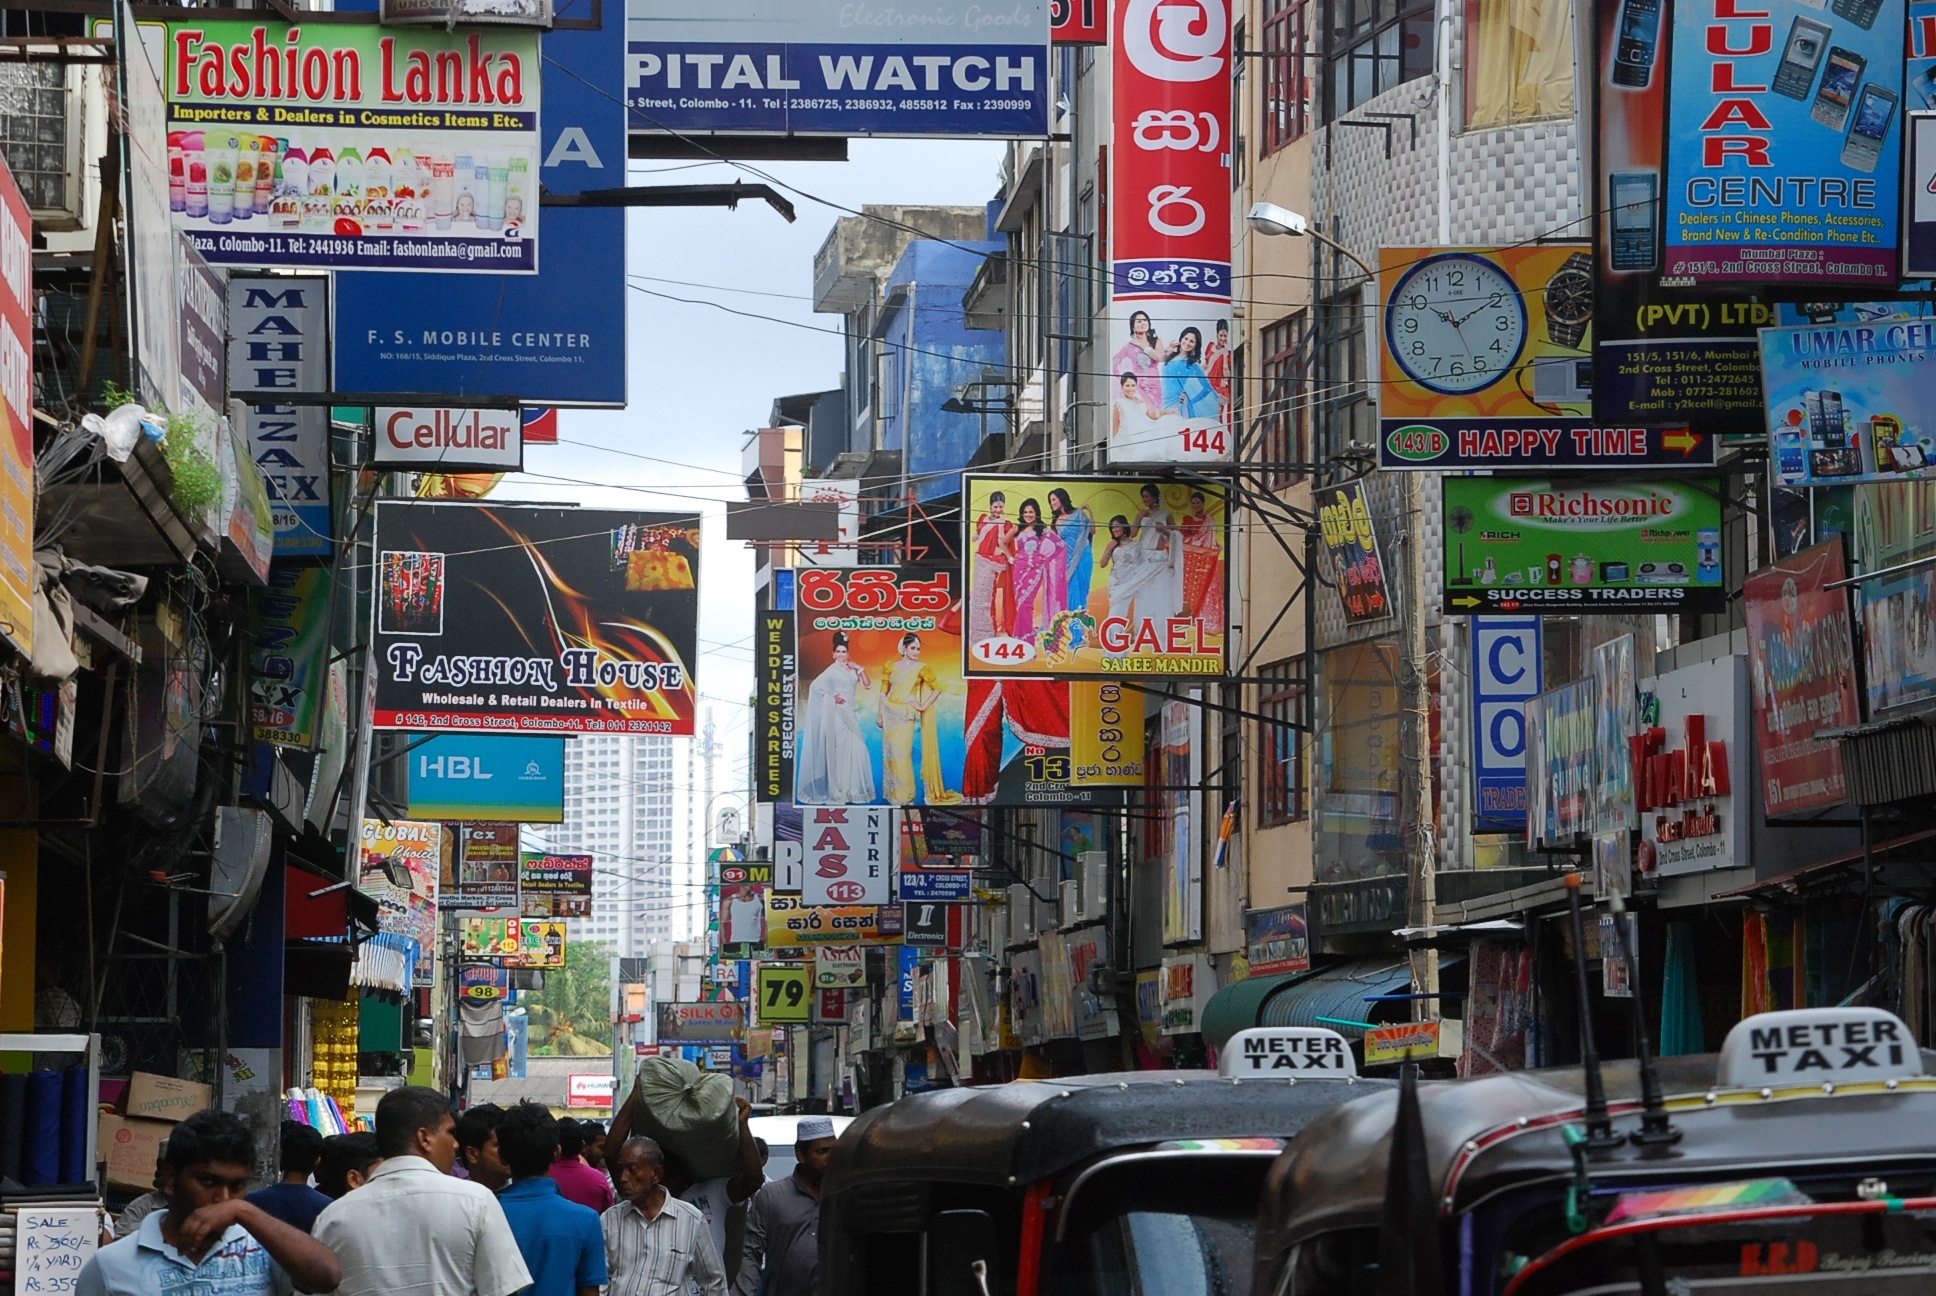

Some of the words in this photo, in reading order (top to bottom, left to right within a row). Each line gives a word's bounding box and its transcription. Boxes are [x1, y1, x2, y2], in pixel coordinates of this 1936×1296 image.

[840, 3, 956, 29] Electronic
[964, 3, 1033, 29] Goods
[172, 26, 364, 104] Fashion
[378, 33, 525, 106] Lanka
[818, 55, 1035, 92] WATCH
[638, 98, 677, 110] Street,
[679, 98, 730, 110] Colombo
[763, 99, 781, 110] Tel
[790, 99, 843, 112] 2386725,
[845, 99, 898, 112] 2386932,
[899, 99, 948, 111] 4855812
[953, 100, 974, 111] Fax
[984, 99, 1032, 112] 2390999
[173, 104, 252, 122] Importers
[256, 109, 270, 122] &
[275, 108, 335, 125] Dealers
[340, 111, 356, 125] in
[360, 110, 441, 127] Cosmetics
[445, 113, 489, 128] Items
[493, 114, 524, 129] Etc.
[543, 126, 605, 169] A
[1686, 177, 1876, 209] CENTRE
[1679, 212, 1718, 225] Dealers
[1721, 212, 1732, 224] in
[1735, 212, 1778, 225] Chinese
[1781, 212, 1822, 227] Phones,
[1825, 213, 1885, 228] Accessories,
[1681, 229, 1712, 242] Brand
[1715, 229, 1741, 242] New
[1743, 229, 1751, 241] &
[1753, 229, 1824, 242] Re-Condition
[1827, 229, 1858, 242] Phone
[219, 236, 286, 254] Colombo-11.
[288, 237, 307, 253] Tel:
[309, 239, 355, 255] 2441936
[357, 240, 391, 256] Email:
[393, 240, 522, 260] fashonlanka@gmail.com
[1788, 249, 1816, 261] Plaza
[1722, 262, 1743, 274] 2nd
[1746, 263, 1780, 274] Cross
[1783, 263, 1823, 276] Street,
[1827, 263, 1872, 276] Colombo
[1636, 303, 1710, 332] (PVT)
[1720, 303, 1774, 326] LTD.
[368, 330, 385, 345] F.
[394, 331, 413, 345] S.
[423, 331, 502, 346] MOBILE
[511, 333, 591, 348] CENTER
[1793, 328, 1876, 356] UMAR
[380, 352, 395, 361] NO:
[423, 353, 456, 363] Siddique
[456, 353, 478, 363] Plaza,
[494, 354, 514, 363] Cross
[515, 355, 538, 364] Street,
[539, 355, 573, 364] Colombo
[1626, 352, 1664, 363] 151/5,
[1666, 352, 1702, 363] 151/6,
[1704, 350, 1750, 361] Mumbai
[1802, 357, 1857, 369] MOBILE
[1866, 353, 1925, 365] PHONES
[1618, 364, 1641, 375] 2nd
[1643, 364, 1673, 375] Cross
[1675, 363, 1711, 376] Street,
[1655, 375, 1671, 386] Tel
[1681, 375, 1755, 385] 011-2472645
[1651, 387, 1675, 398] Mob
[1686, 386, 1759, 397] 0773-281602
[1628, 400, 1665, 410] E-mail
[387, 409, 511, 450] Cellular
[1177, 427, 1226, 455] 144
[1393, 431, 1443, 454] 143/B
[1458, 428, 1563, 457] HAPPY
[1569, 428, 1648, 456] TIME
[1538, 492, 1673, 517] Richsonic
[1543, 515, 1575, 525] Make's
[1576, 515, 1599, 525] Your
[1600, 515, 1619, 525] Life
[1620, 515, 1648, 525] Better
[1487, 588, 1583, 600] SUCCESS
[1588, 588, 1685, 600] TRADERS
[1100, 616, 1222, 656] GAEL
[979, 642, 1026, 659] 144
[766, 618, 784, 705] WEDDING
[1101, 657, 1153, 673] SAREE
[1154, 657, 1220, 673] MANDIR
[422, 692, 485, 707] Wholesale
[488, 695, 498, 707] &
[501, 694, 537, 708] Retail
[540, 696, 588, 709] Dealers
[604, 698, 648, 711] Textile
[405, 715, 428, 727] 146,
[429, 715, 449, 726] 2nd
[451, 716, 478, 727] Cross
[481, 717, 519, 729] Street,
[520, 717, 583, 730] Colombo-11.
[586, 719, 606, 730] Tel:
[607, 720, 625, 731] 011
[628, 720, 672, 732] 2321142
[767, 711, 780, 797] SAREES
[1025, 746, 1045, 756] No
[420, 755, 494, 779] HBL
[1025, 781, 1045, 791] 2nd
[1025, 792, 1073, 802] Colombo
[362, 823, 429, 842] GLOBAL
[462, 828, 496, 841] Tex
[391, 845, 435, 860] Choice
[726, 871, 744, 879] 91
[828, 885, 866, 900] 113
[907, 931, 944, 941] Electronics
[820, 950, 862, 962] ASIAN
[716, 968, 736, 980] RA
[474, 987, 493, 998] 98
[766, 979, 804, 1007] 79
[680, 1008, 715, 1019] SILK
[1750, 1020, 1901, 1051] METER
[1243, 1037, 1343, 1054] METER
[1244, 1053, 1345, 1070] TAXI
[1751, 1044, 1904, 1074] TAXI
[26, 1216, 70, 1230] SALE
[46, 1254, 83, 1271] YARD
